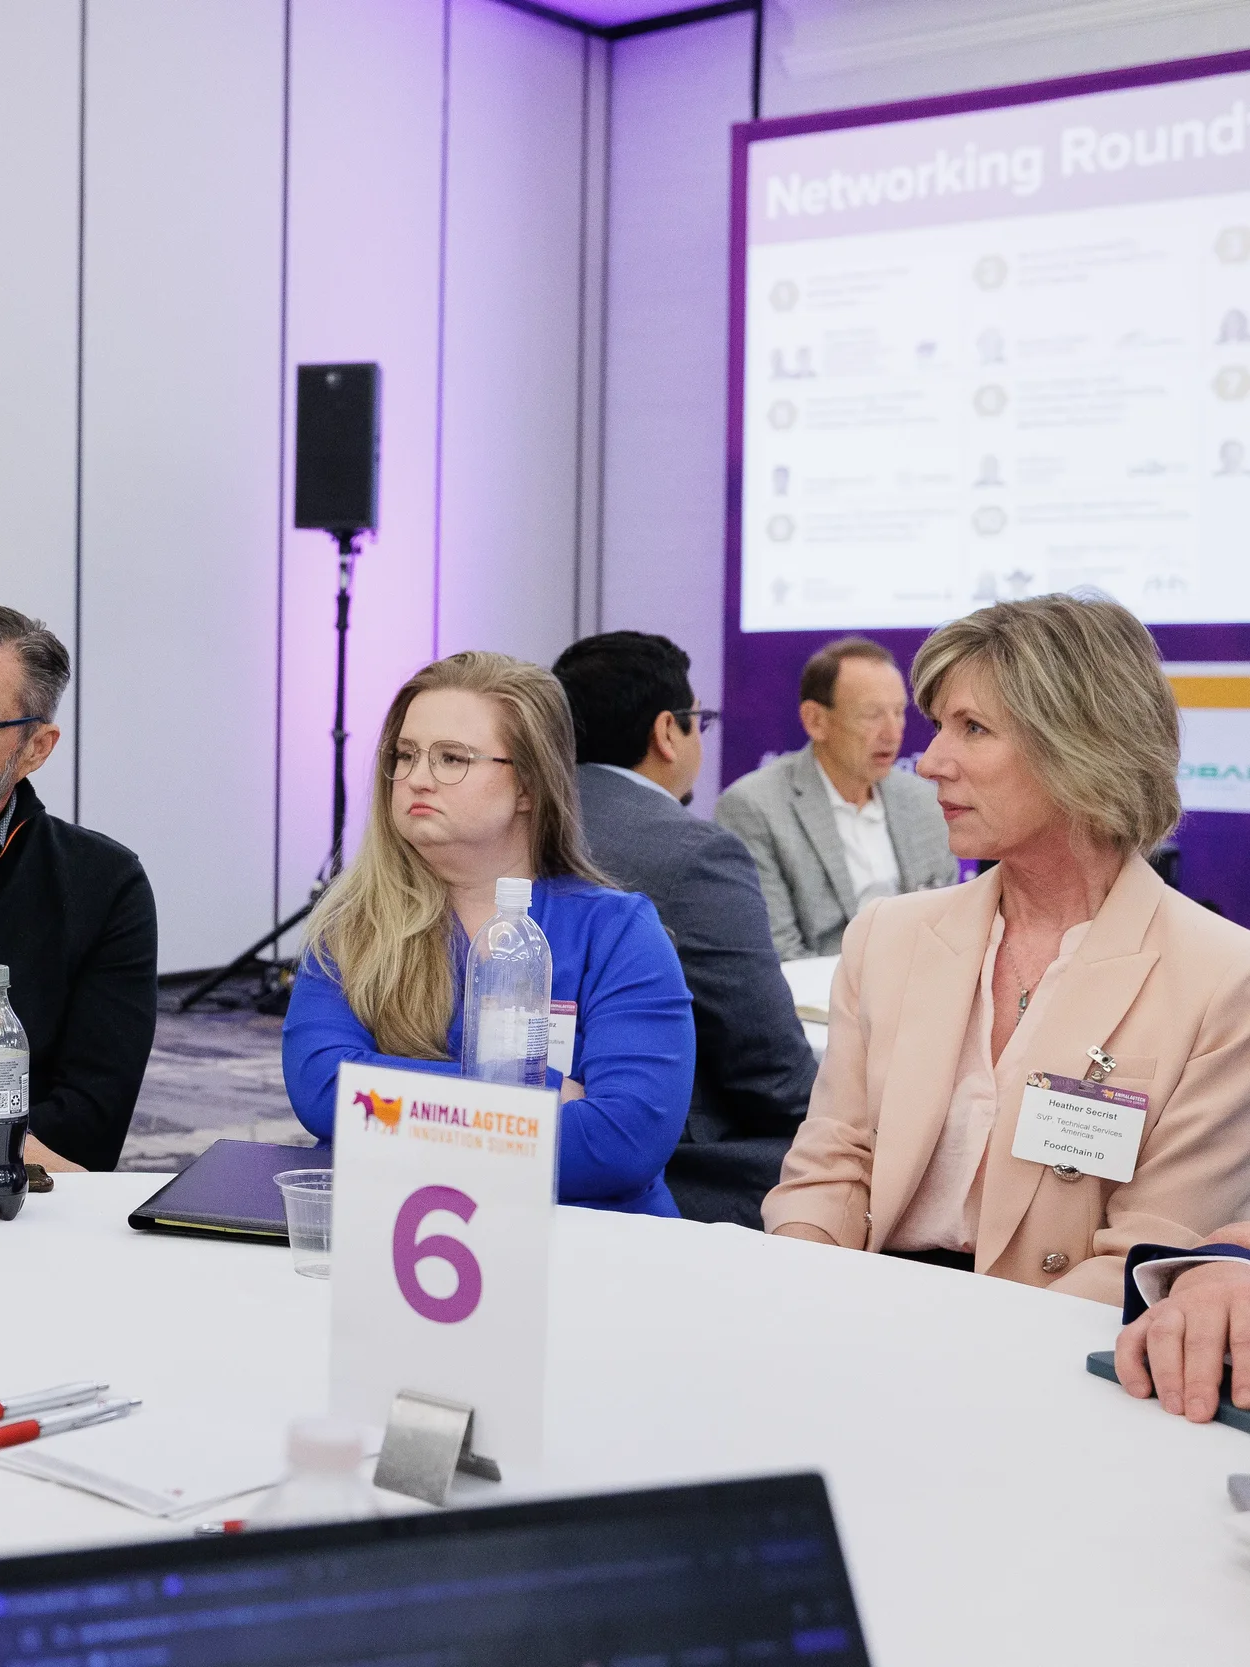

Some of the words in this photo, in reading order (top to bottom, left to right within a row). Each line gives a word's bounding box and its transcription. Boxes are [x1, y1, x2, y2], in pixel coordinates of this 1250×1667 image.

[765, 142, 1045, 219] Networking
[1060, 100, 1250, 176] Round
[409, 1100, 539, 1139] ANIMALAGTECH
[1048, 1099, 1084, 1113] Heather
[1086, 1107, 1117, 1120] Secrist
[408, 1124, 484, 1149] INNOVATION
[486, 1135, 538, 1158] SUMMIT
[1057, 1117, 1091, 1130] Technical
[1092, 1125, 1123, 1138] Services
[1061, 1127, 1094, 1139] Americas
[1043, 1140, 1092, 1157] FoodChain
[1095, 1151, 1105, 1160] ID
[392, 1184, 483, 1325] 6
